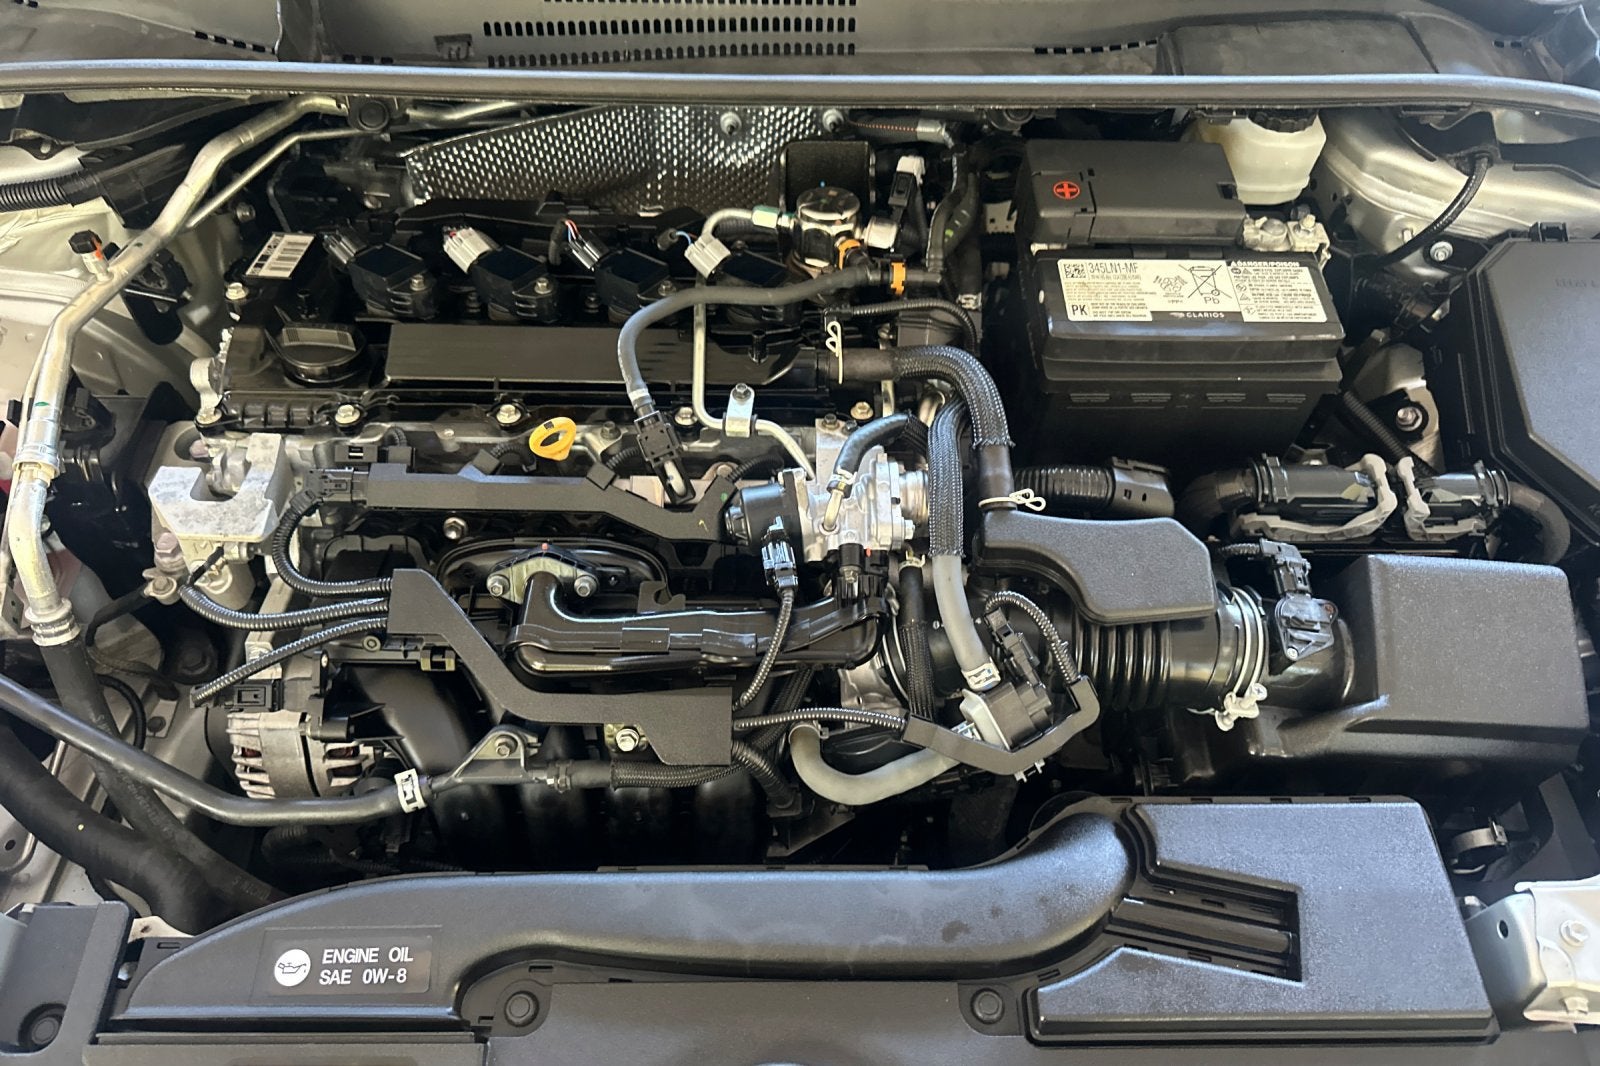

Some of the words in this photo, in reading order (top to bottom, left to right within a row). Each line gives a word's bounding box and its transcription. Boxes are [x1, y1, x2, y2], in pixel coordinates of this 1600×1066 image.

[1088, 262, 1138, 273] 345LN1-MF
[1203, 296, 1220, 304] Pb
[1071, 304, 1088, 316] PK
[322, 947, 379, 964] ENGINE
[388, 946, 414, 963] OIL
[318, 969, 353, 985] SAE
[362, 967, 407, 984] 0W-8
